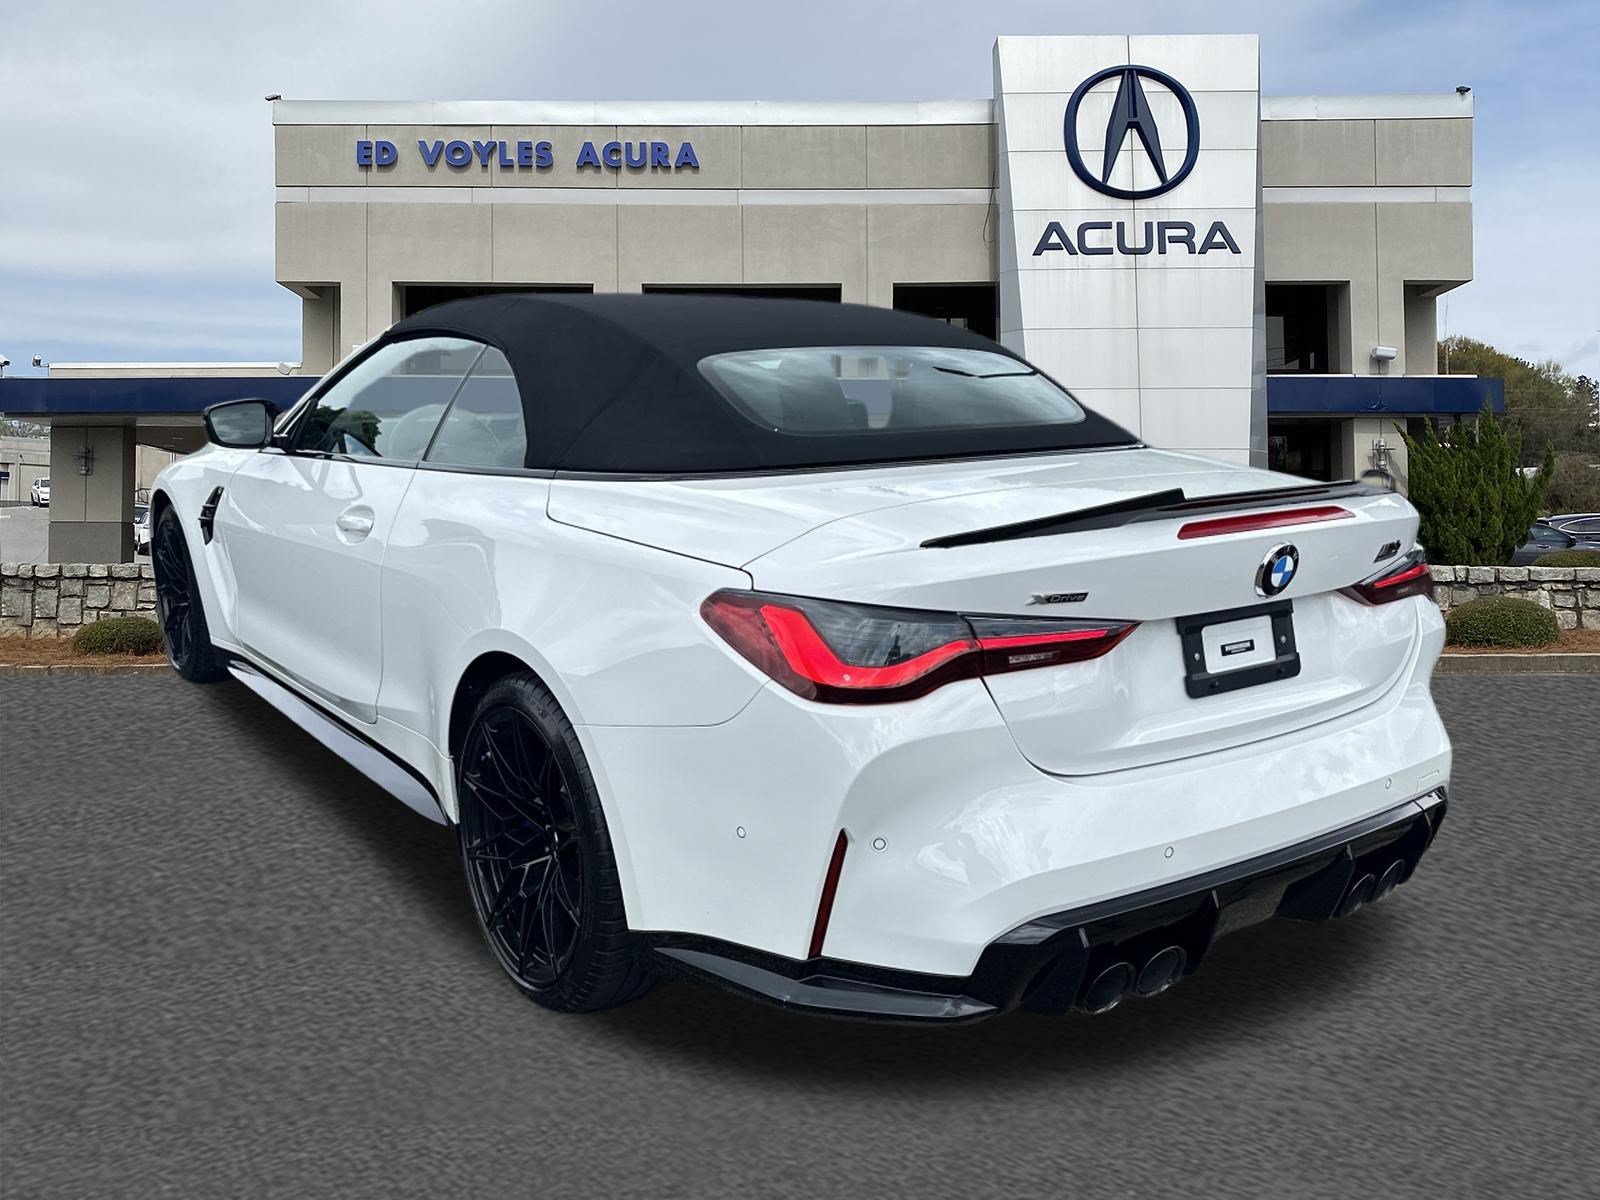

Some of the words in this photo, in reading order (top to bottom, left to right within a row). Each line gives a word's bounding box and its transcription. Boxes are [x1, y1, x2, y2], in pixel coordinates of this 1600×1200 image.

[356, 140, 398, 167] ED
[418, 140, 554, 168] VOYLES
[576, 141, 700, 169] ACURA
[1032, 221, 1242, 256] ACURA
